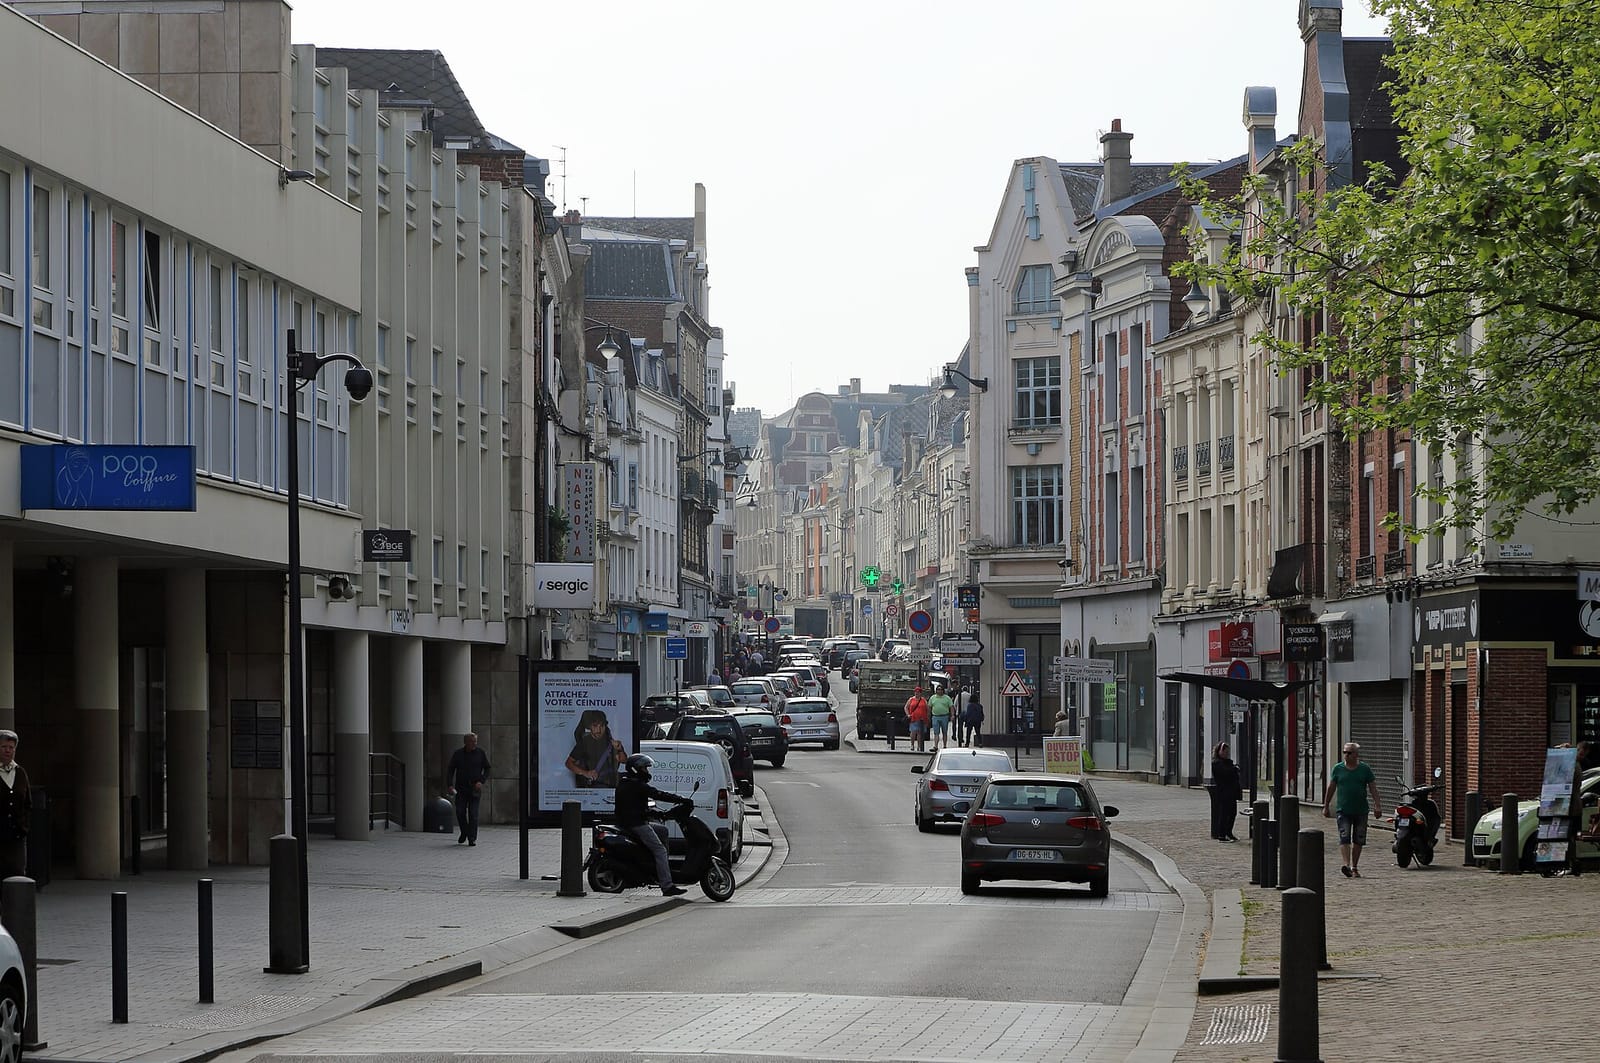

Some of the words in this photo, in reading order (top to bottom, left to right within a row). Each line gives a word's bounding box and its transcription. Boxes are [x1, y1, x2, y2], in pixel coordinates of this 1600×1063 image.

[103, 455, 158, 478] pop
[123, 470, 177, 492] Coiffure
[574, 468, 582, 556] NAGOYA
[386, 542, 404, 550] BGE
[546, 578, 589, 594] sergic
[544, 690, 588, 698] ATTACHEZ
[544, 698, 573, 706] VOTRE
[576, 698, 617, 707] CEINTURE
[1047, 742, 1080, 751] OUVERT
[1053, 751, 1080, 762] STOP
[652, 760, 667, 769] De
[669, 760, 706, 771] Cauwer
